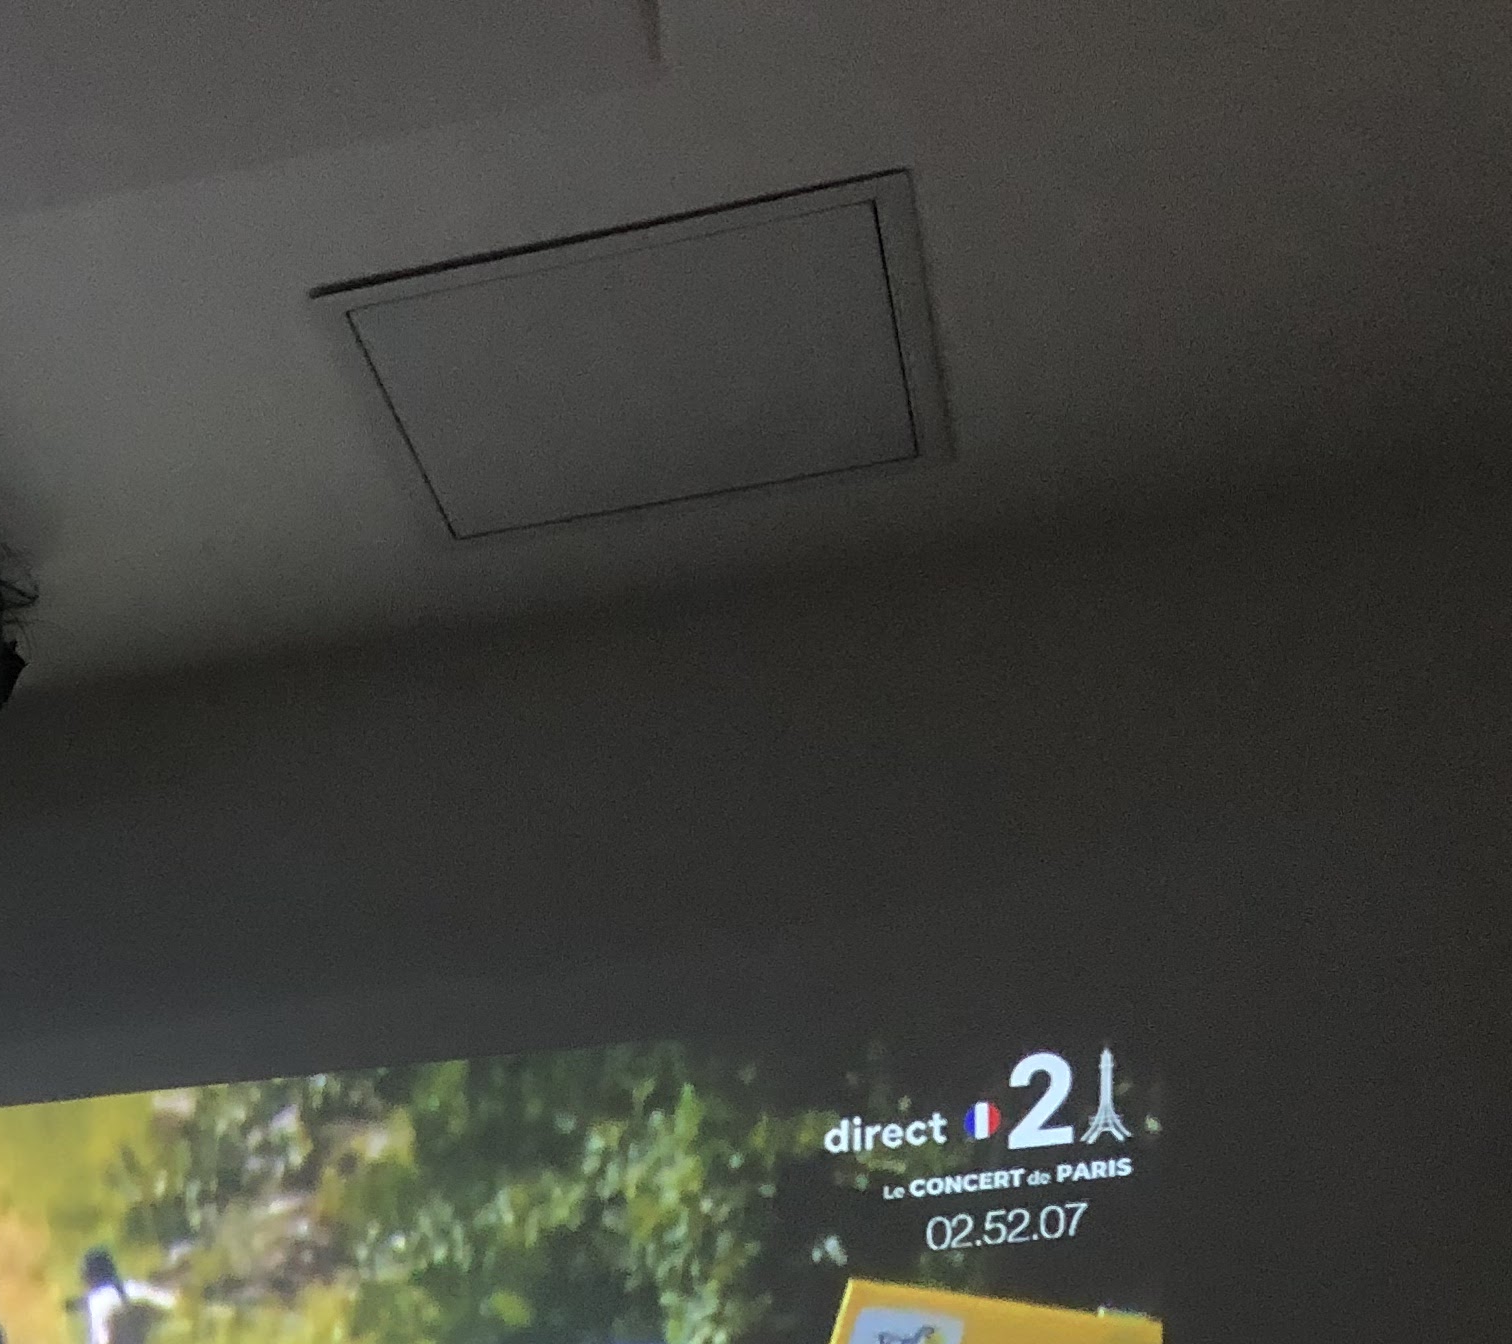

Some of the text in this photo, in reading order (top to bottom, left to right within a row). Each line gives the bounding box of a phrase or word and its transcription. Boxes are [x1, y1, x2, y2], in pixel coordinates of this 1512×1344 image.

[824, 1051, 1075, 1154] direct 2
[883, 1158, 1134, 1201] Le CONCERT de PARIS
[926, 1202, 1089, 1252] 02.52.07
